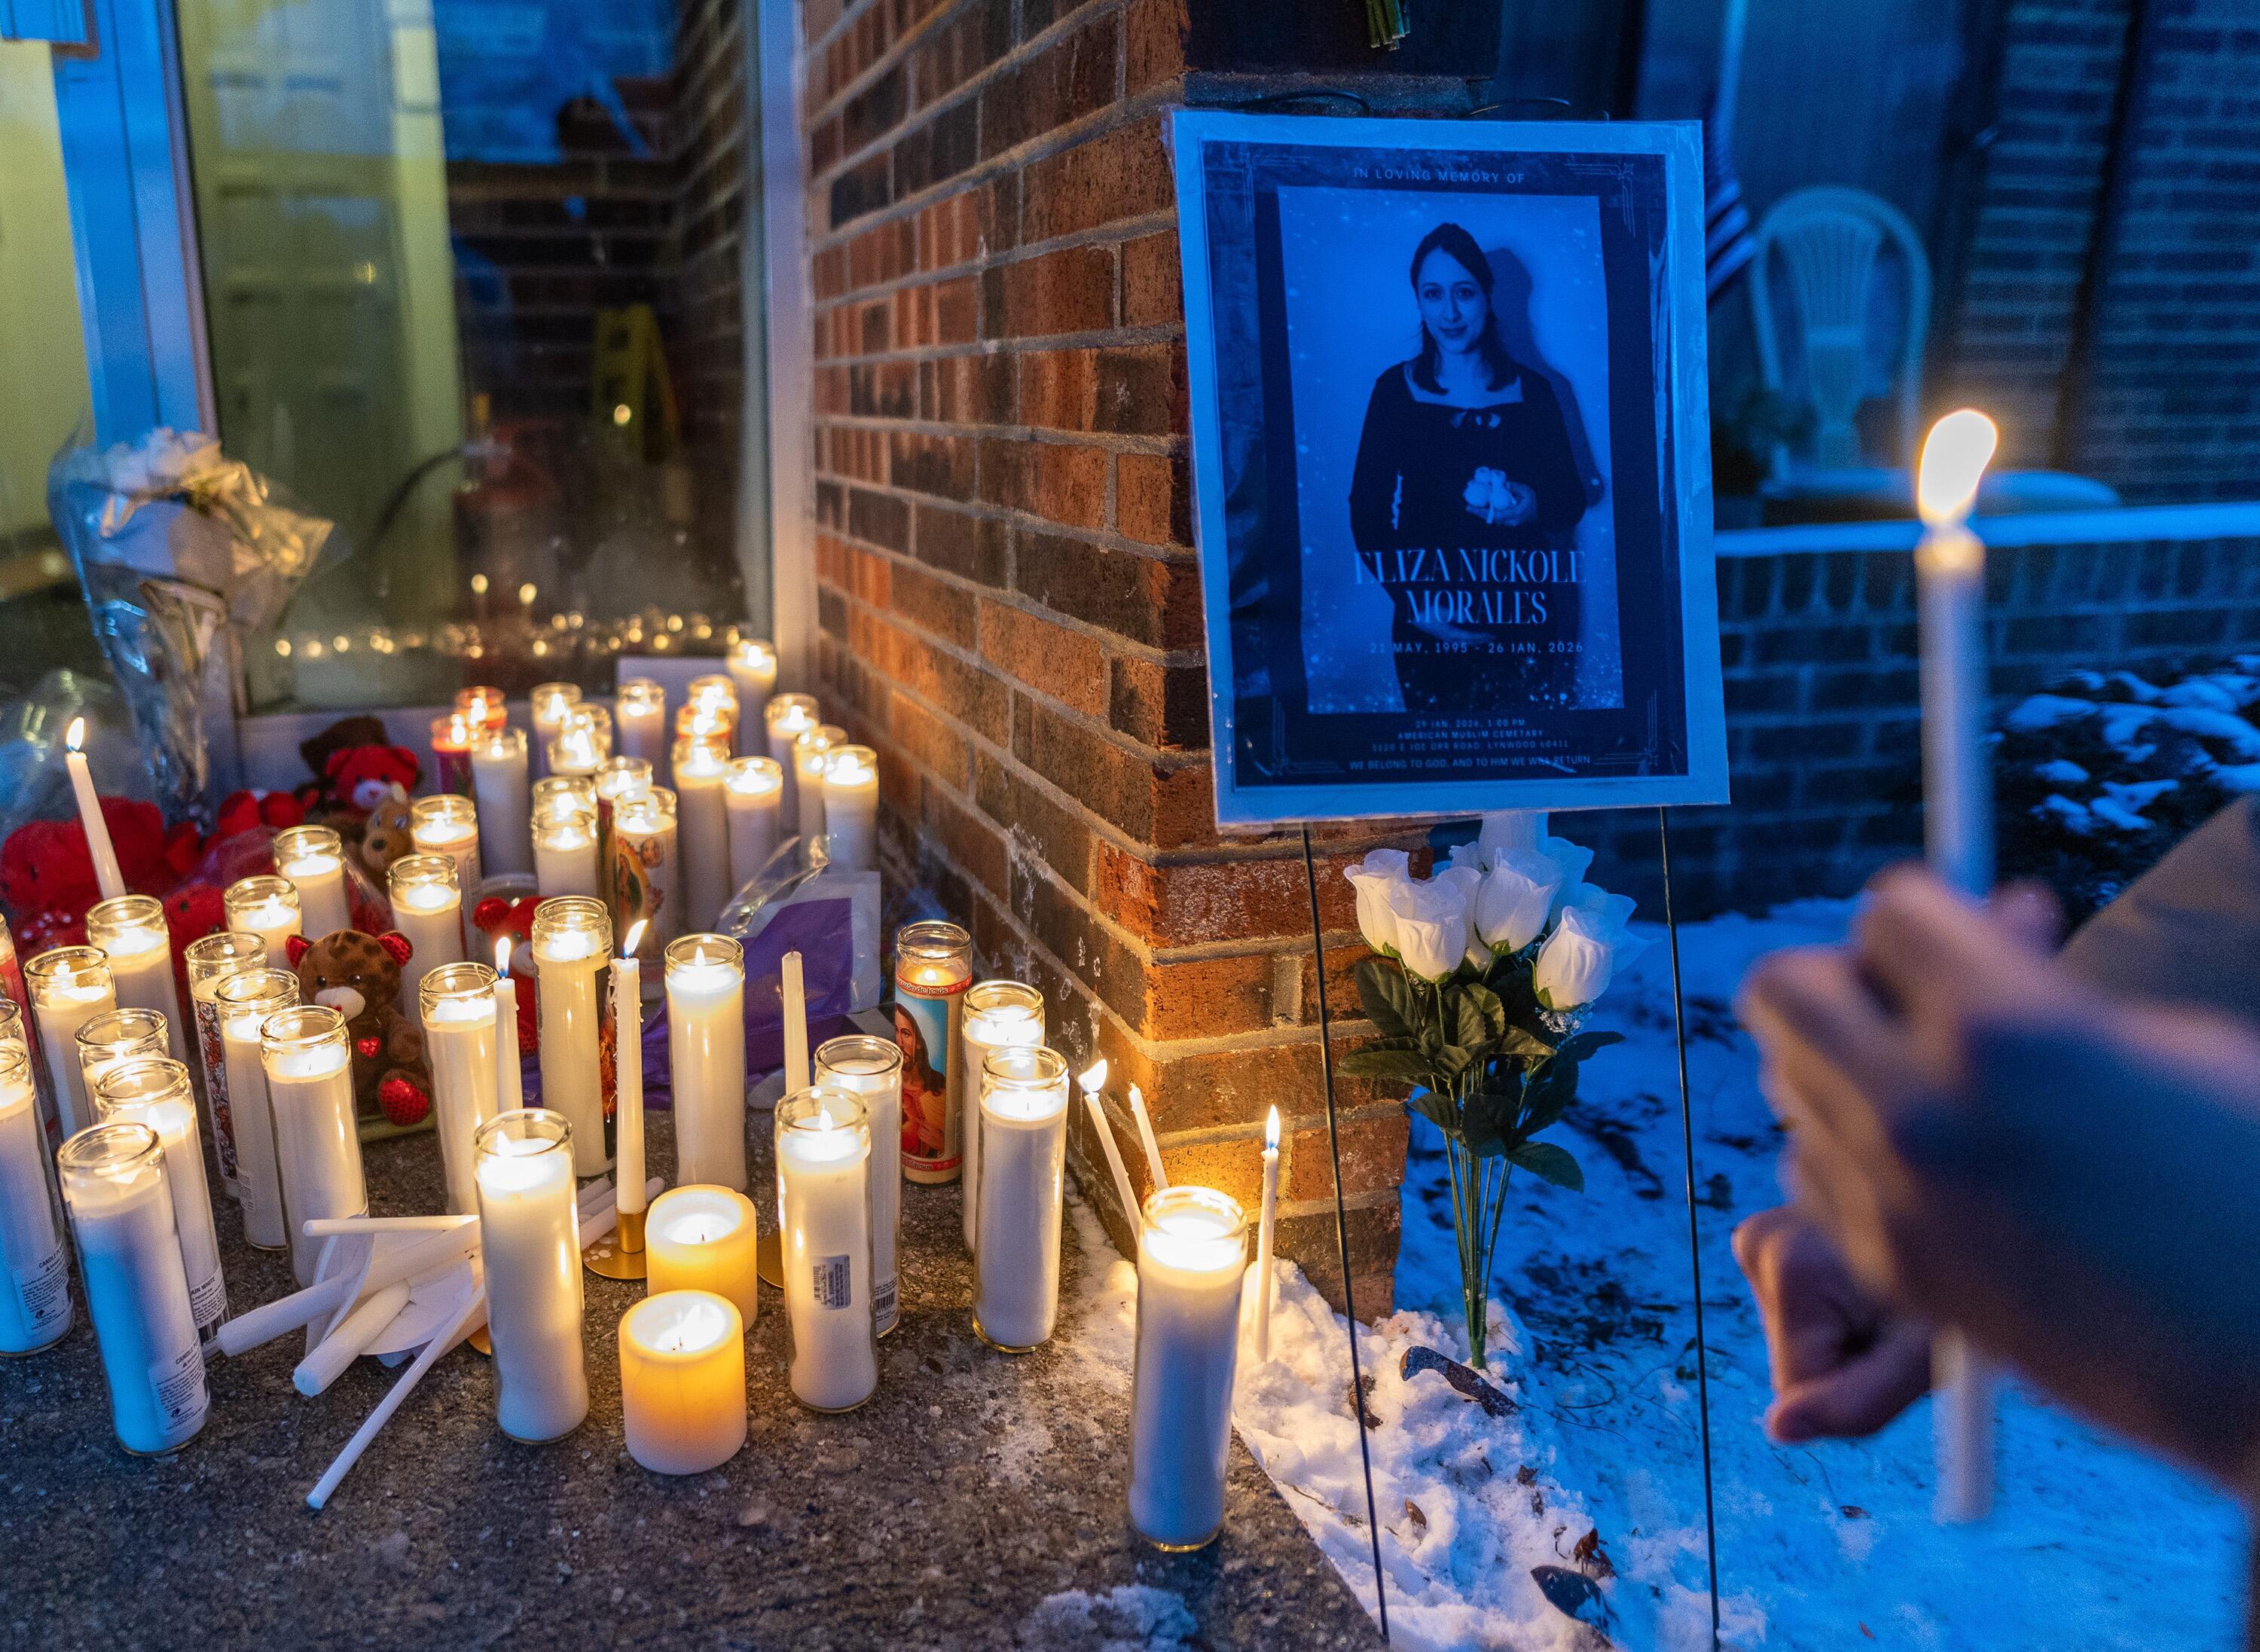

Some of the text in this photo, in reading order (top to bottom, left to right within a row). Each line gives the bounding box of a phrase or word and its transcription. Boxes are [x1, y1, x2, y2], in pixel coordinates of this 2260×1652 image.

[1354, 167, 1525, 184] IN LOVING MEMORY OF
[1353, 548, 1587, 585] ELIZA NICKOLE
[1406, 589, 1548, 624] MORALES
[1370, 643, 1386, 653] 21
[1435, 642, 1468, 654] 1995
[1488, 642, 1504, 653] 26
[1548, 641, 1584, 653] 2026
[1511, 717, 1526, 727] PM
[1397, 731, 1448, 740] AMERICAN
[1451, 730, 1489, 740] MUSLIM
[1487, 740, 1536, 750] LYNWOOD
[1349, 760, 1364, 770] WE
[1367, 759, 1407, 769] BELONG
[1409, 759, 1423, 768] TO
[1452, 758, 1474, 768] AND
[1476, 757, 1489, 767] TO
[1490, 756, 1508, 766] HIM
[1510, 756, 1526, 766] WE
[1553, 754, 1591, 765] RETURN
[927, 986, 948, 995] Jesús
